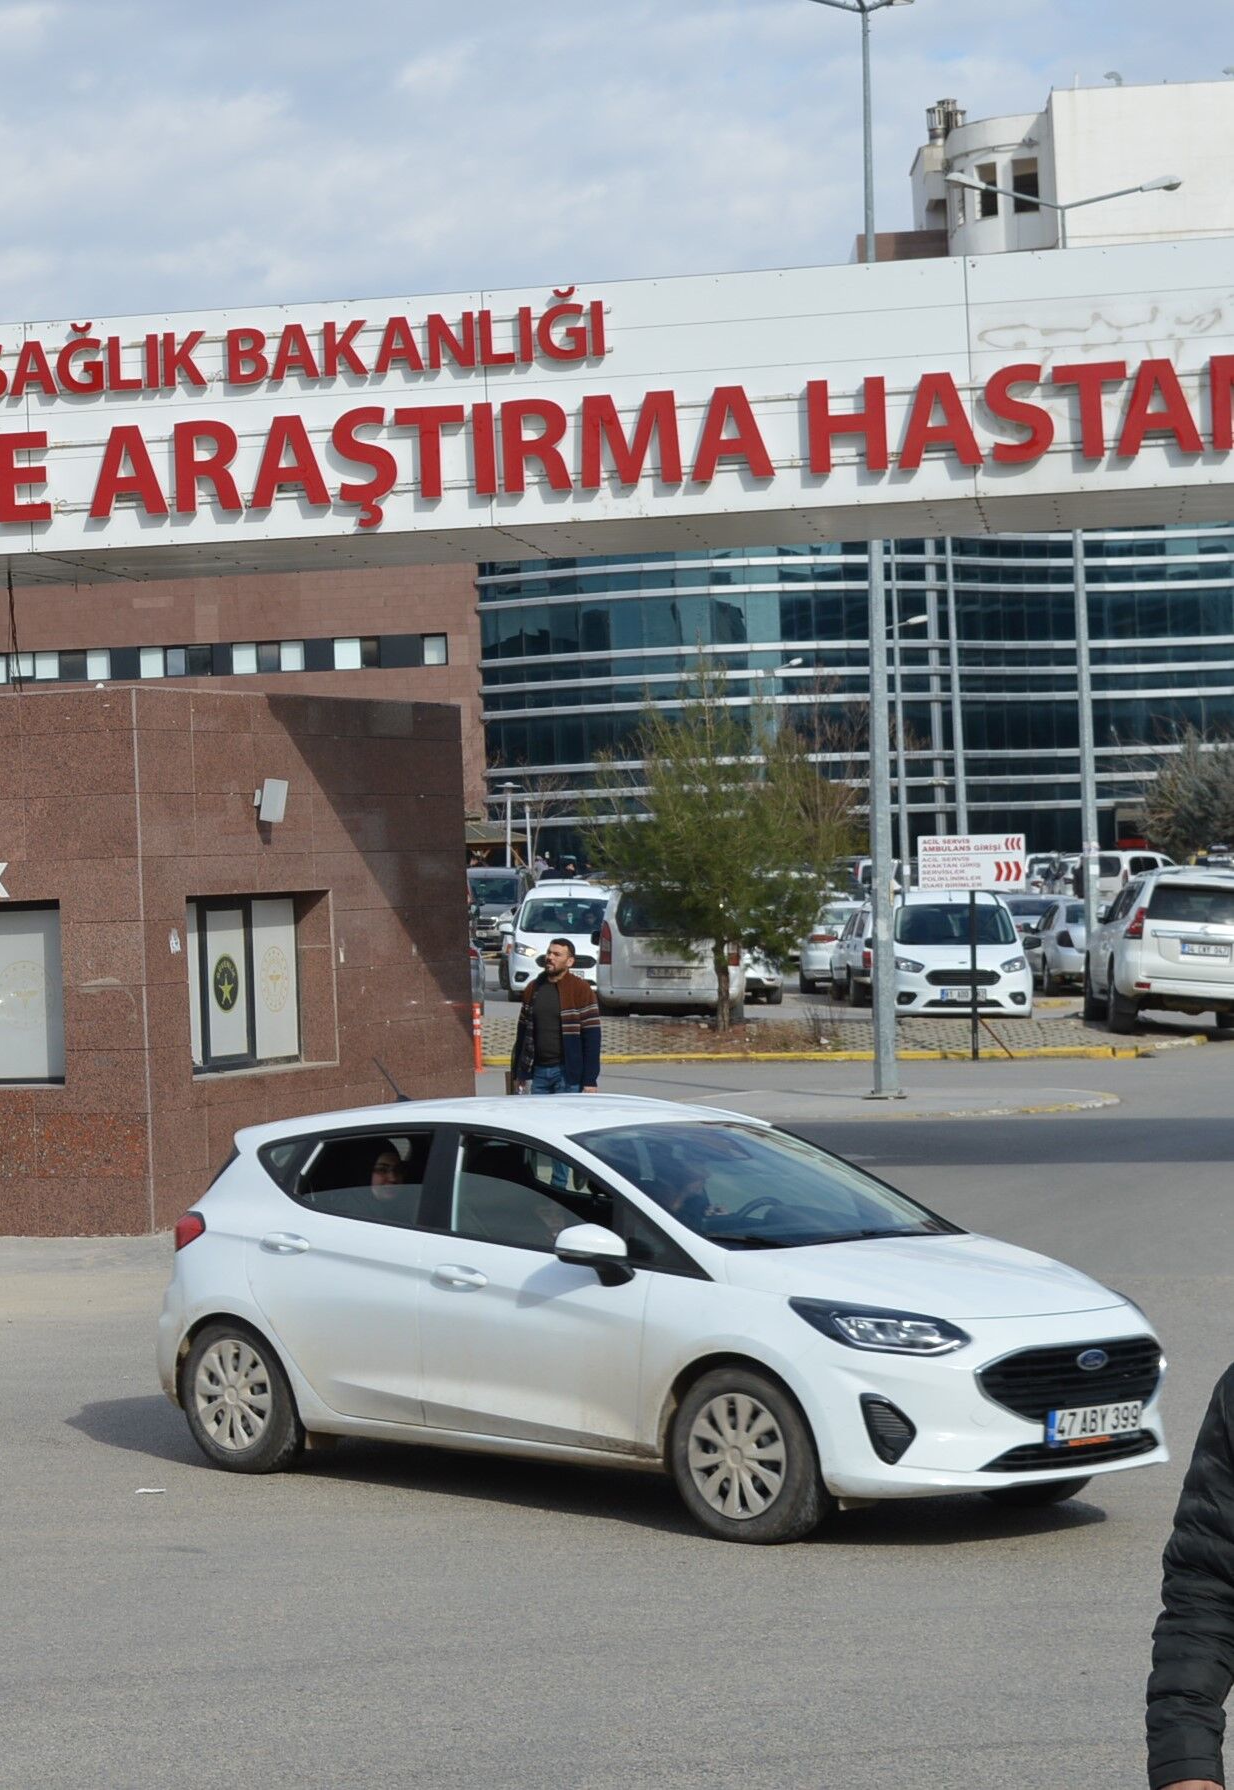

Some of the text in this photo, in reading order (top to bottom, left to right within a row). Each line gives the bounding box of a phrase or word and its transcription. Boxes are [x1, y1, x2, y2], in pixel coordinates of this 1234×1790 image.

[226, 286, 606, 386] BAKANLIĞI
[89, 385, 776, 528] ARAŞTIRMA
[922, 844, 971, 852] AMBULANS
[1057, 1404, 1138, 1436] 47 ABY 399
